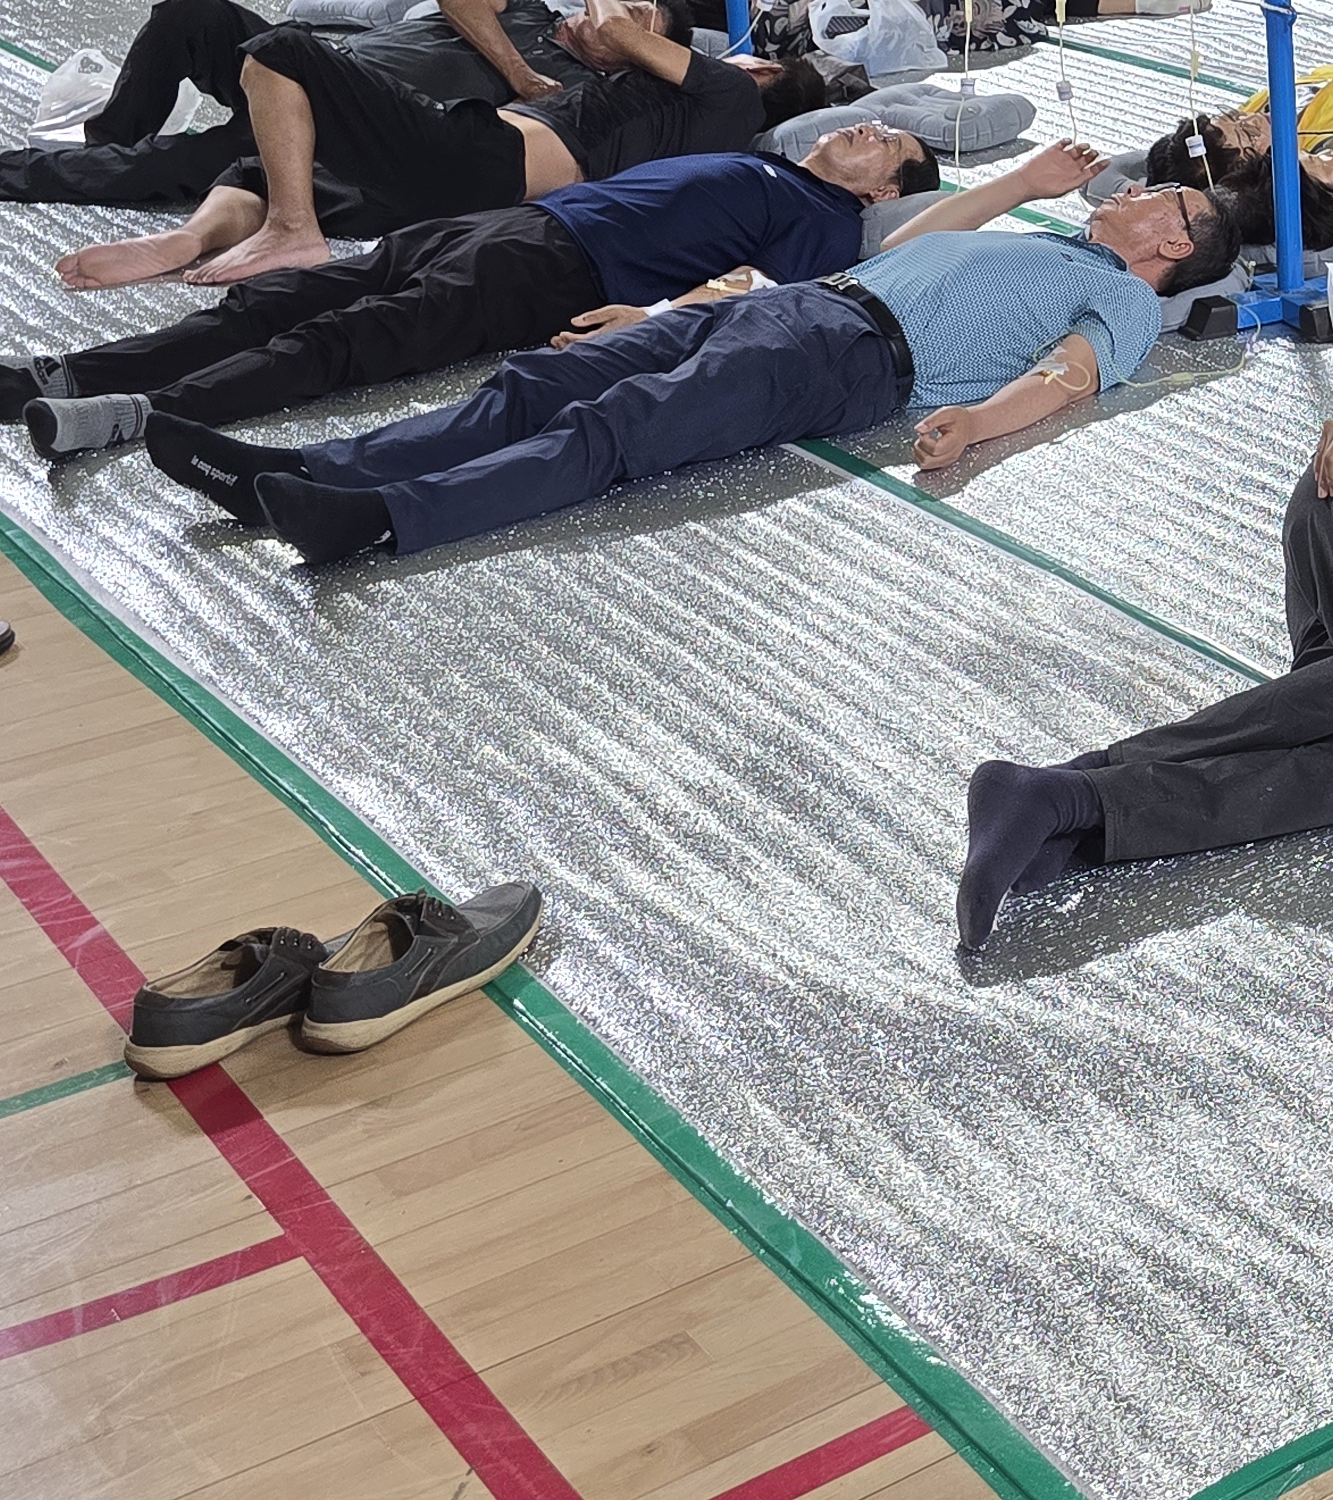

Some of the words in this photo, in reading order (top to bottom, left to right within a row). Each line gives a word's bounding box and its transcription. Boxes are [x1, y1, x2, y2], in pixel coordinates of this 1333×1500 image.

[191, 454, 199, 466] le
[197, 460, 211, 477] coq
[210, 467, 238, 487] sportif
